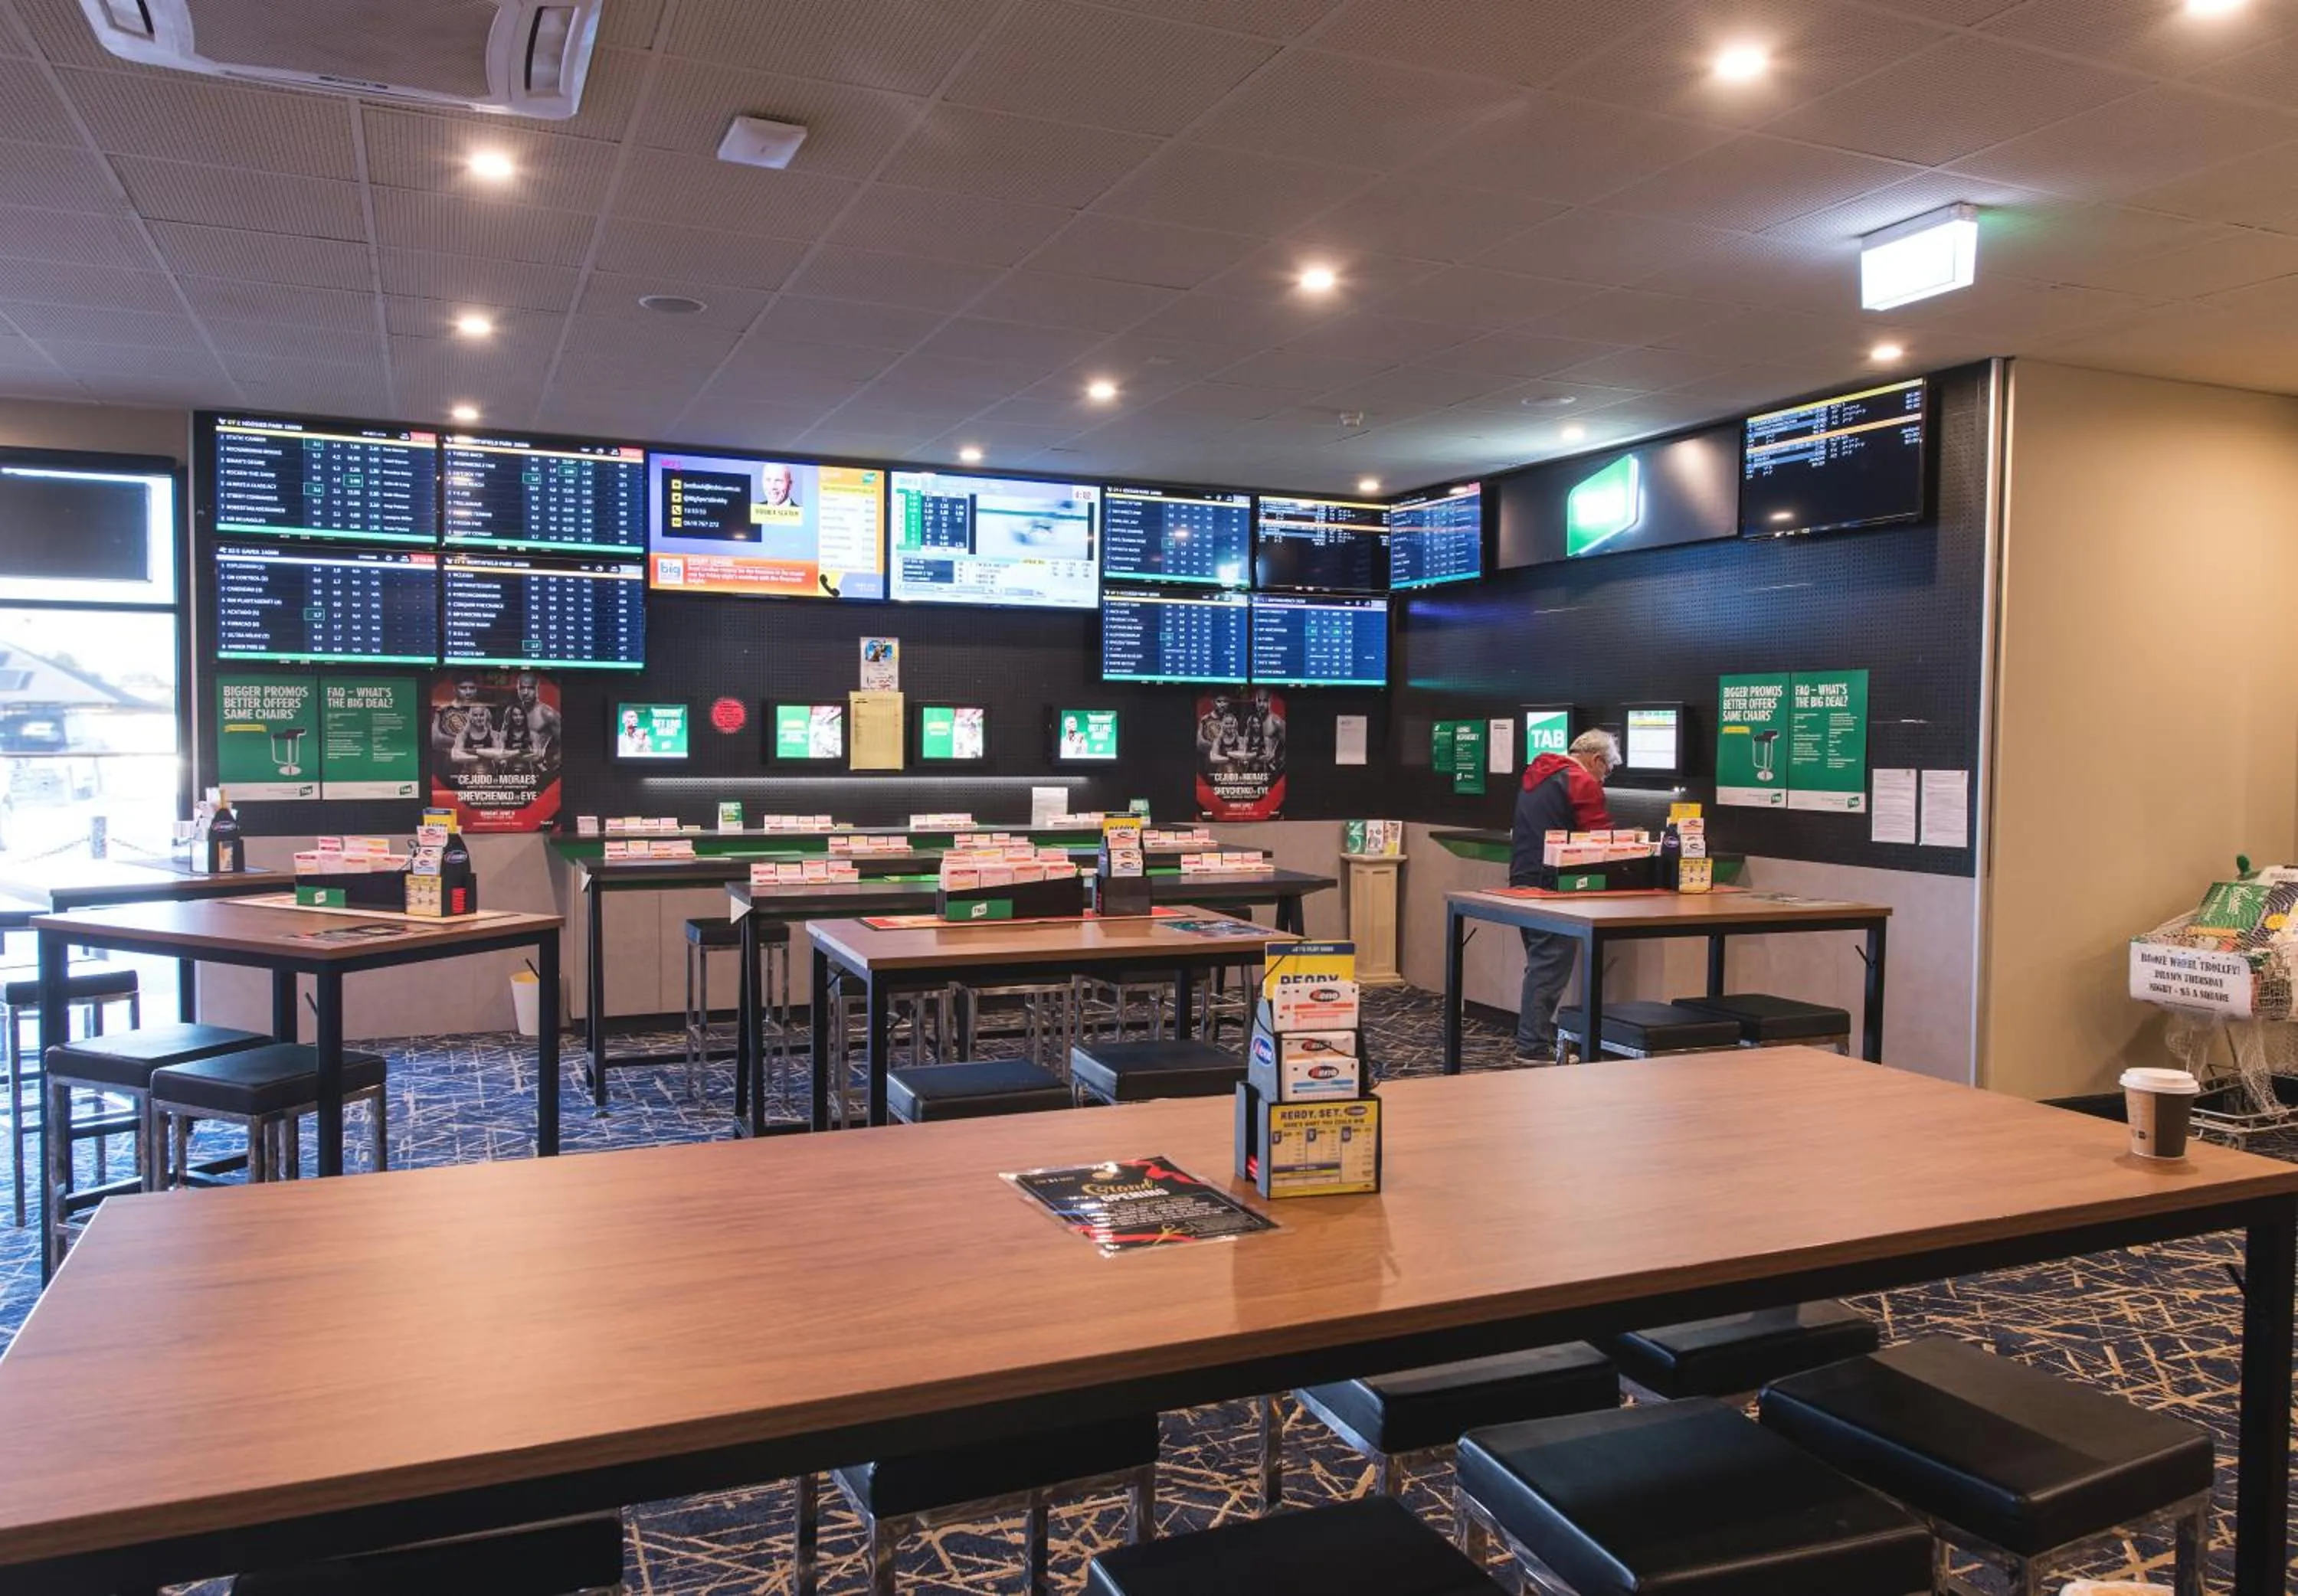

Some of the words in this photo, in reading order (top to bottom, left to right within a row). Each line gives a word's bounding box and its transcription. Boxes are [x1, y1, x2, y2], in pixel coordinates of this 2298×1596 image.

[223, 685, 261, 697] BIGGER
[264, 686, 309, 698] PROMOS
[326, 687, 345, 698] FAQ
[356, 688, 391, 698] WHAT'S
[1724, 686, 1749, 698] BIGGER
[1750, 685, 1782, 697] PROMOS
[1795, 685, 1810, 696] FAQ
[1818, 683, 1848, 695] WHAT'S
[223, 697, 260, 708] BETTER
[264, 698, 301, 708] OFFERS
[327, 698, 345, 708] THE
[347, 698, 363, 708] BIG
[365, 698, 394, 708] DEAL?
[1723, 698, 1747, 710] BETTER
[1749, 698, 1777, 709] OFFERS
[1796, 697, 1809, 708] THE
[1810, 696, 1823, 708] BIG
[1825, 696, 1848, 708] DEAL?
[223, 708, 254, 719] SAME
[1723, 711, 1741, 722] SAME
[1531, 729, 1565, 748] TAB
[459, 774, 493, 785] CEJUDO
[499, 774, 537, 785] MORAES
[457, 791, 514, 801] SHEVCHENKO
[521, 792, 537, 800] EYE
[2184, 973, 2223, 987] THURSDAY
[2199, 989, 2230, 1002] SQUARE
[1280, 1110, 1316, 1120] READY.
[1319, 1108, 1342, 1118] SET.
